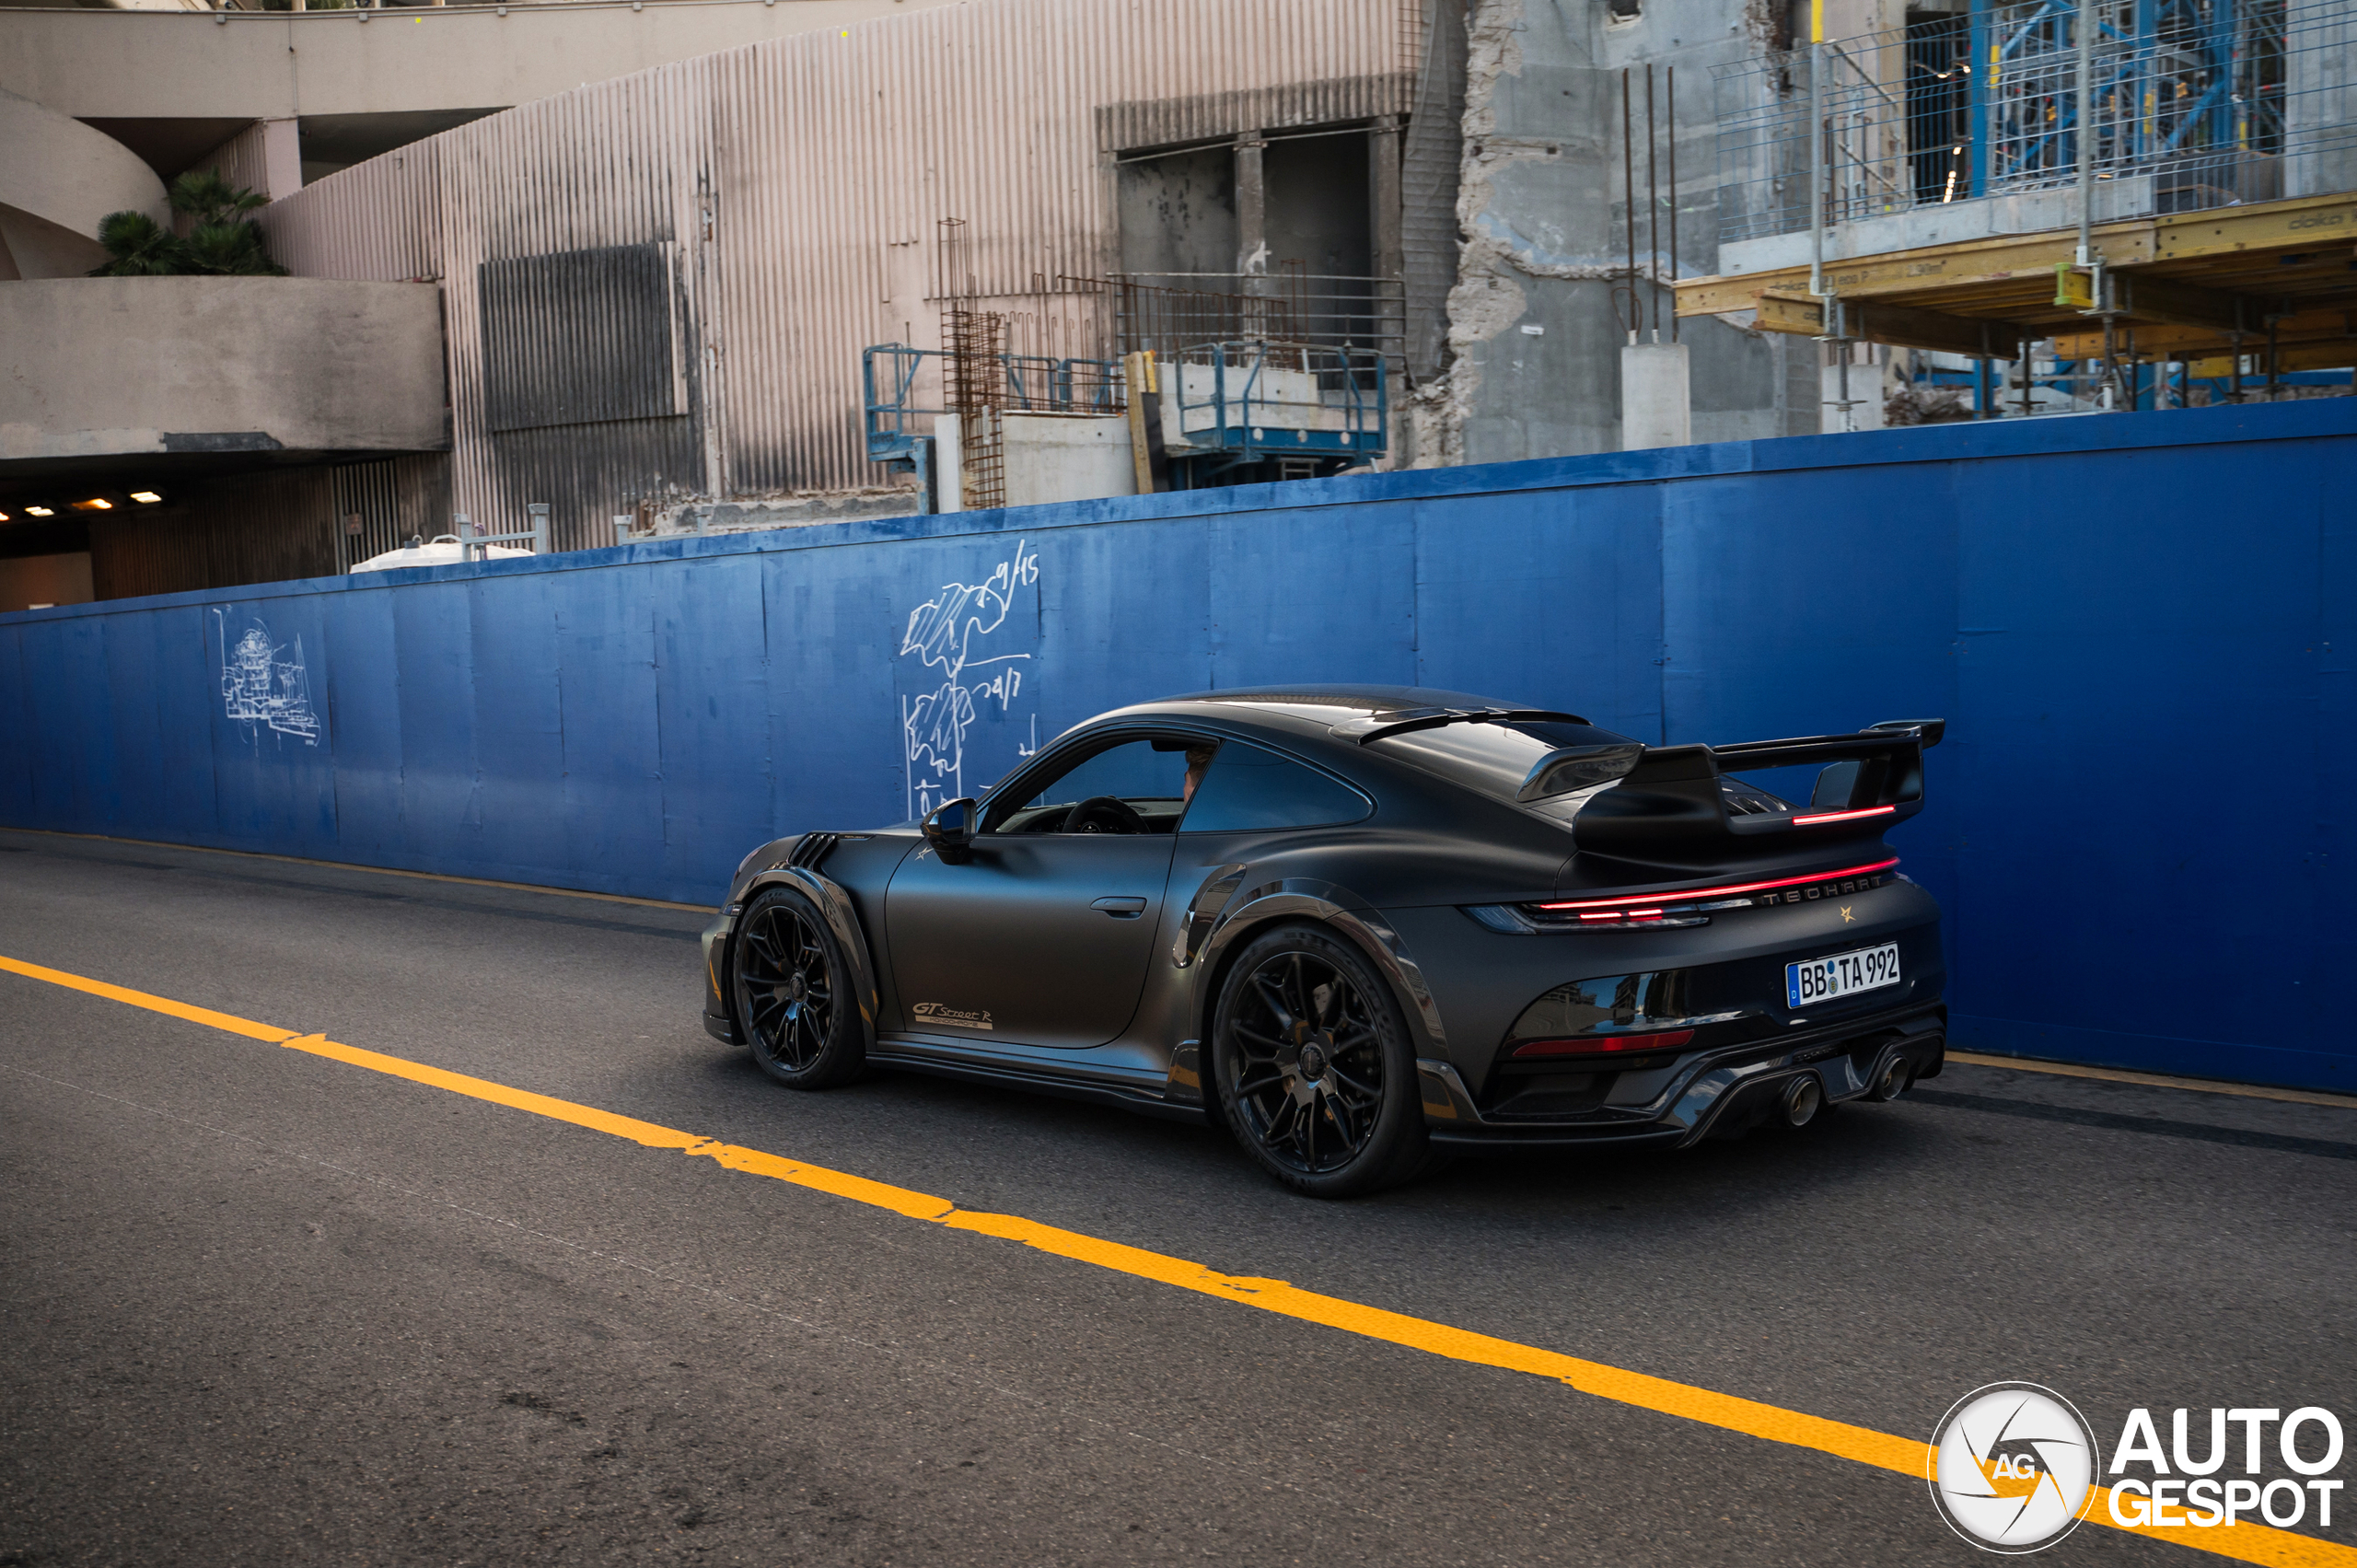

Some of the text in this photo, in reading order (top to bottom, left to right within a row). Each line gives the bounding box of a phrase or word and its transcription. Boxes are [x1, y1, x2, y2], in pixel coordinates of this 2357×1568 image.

[1763, 876, 1881, 905] TECHART
[1801, 948, 1898, 999] BB TA 992
[912, 1002, 993, 1023] GT Street R
[930, 1017, 979, 1028] MONOCHROME
